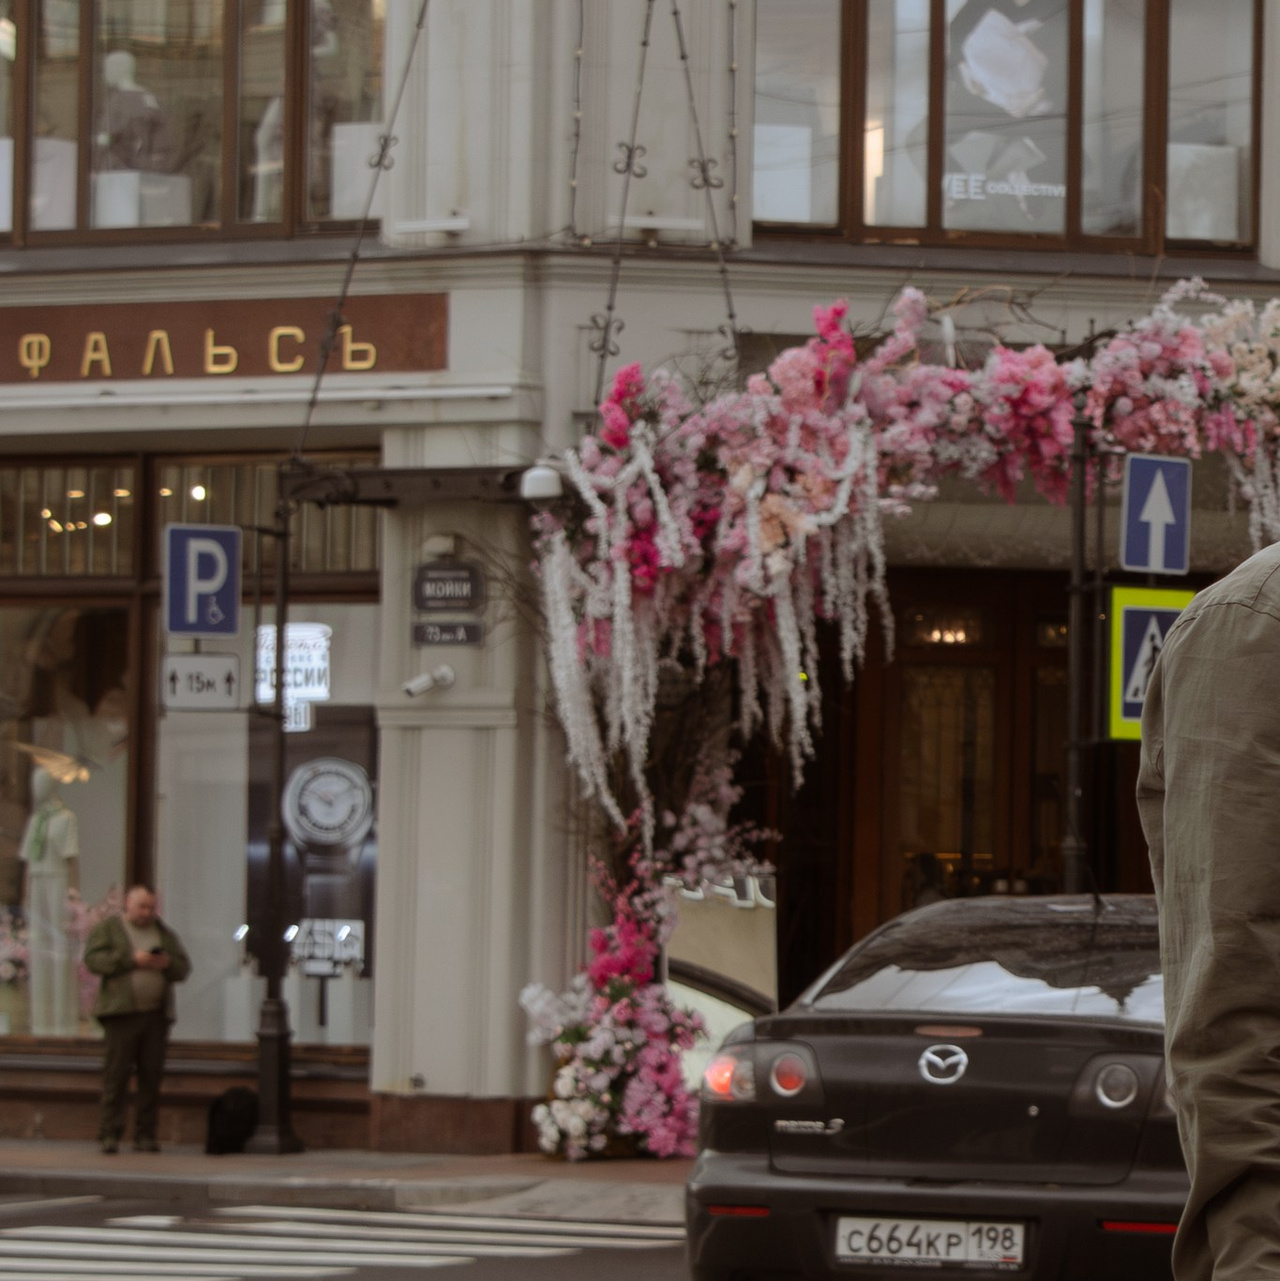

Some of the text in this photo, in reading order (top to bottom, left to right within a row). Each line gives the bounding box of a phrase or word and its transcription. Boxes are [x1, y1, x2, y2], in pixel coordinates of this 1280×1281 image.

[18, 325, 377, 378] ФАЛЬСЪ
[187, 537, 229, 624] P
[423, 579, 471, 598] МОЙКИ
[971, 1226, 1016, 1251] 198
